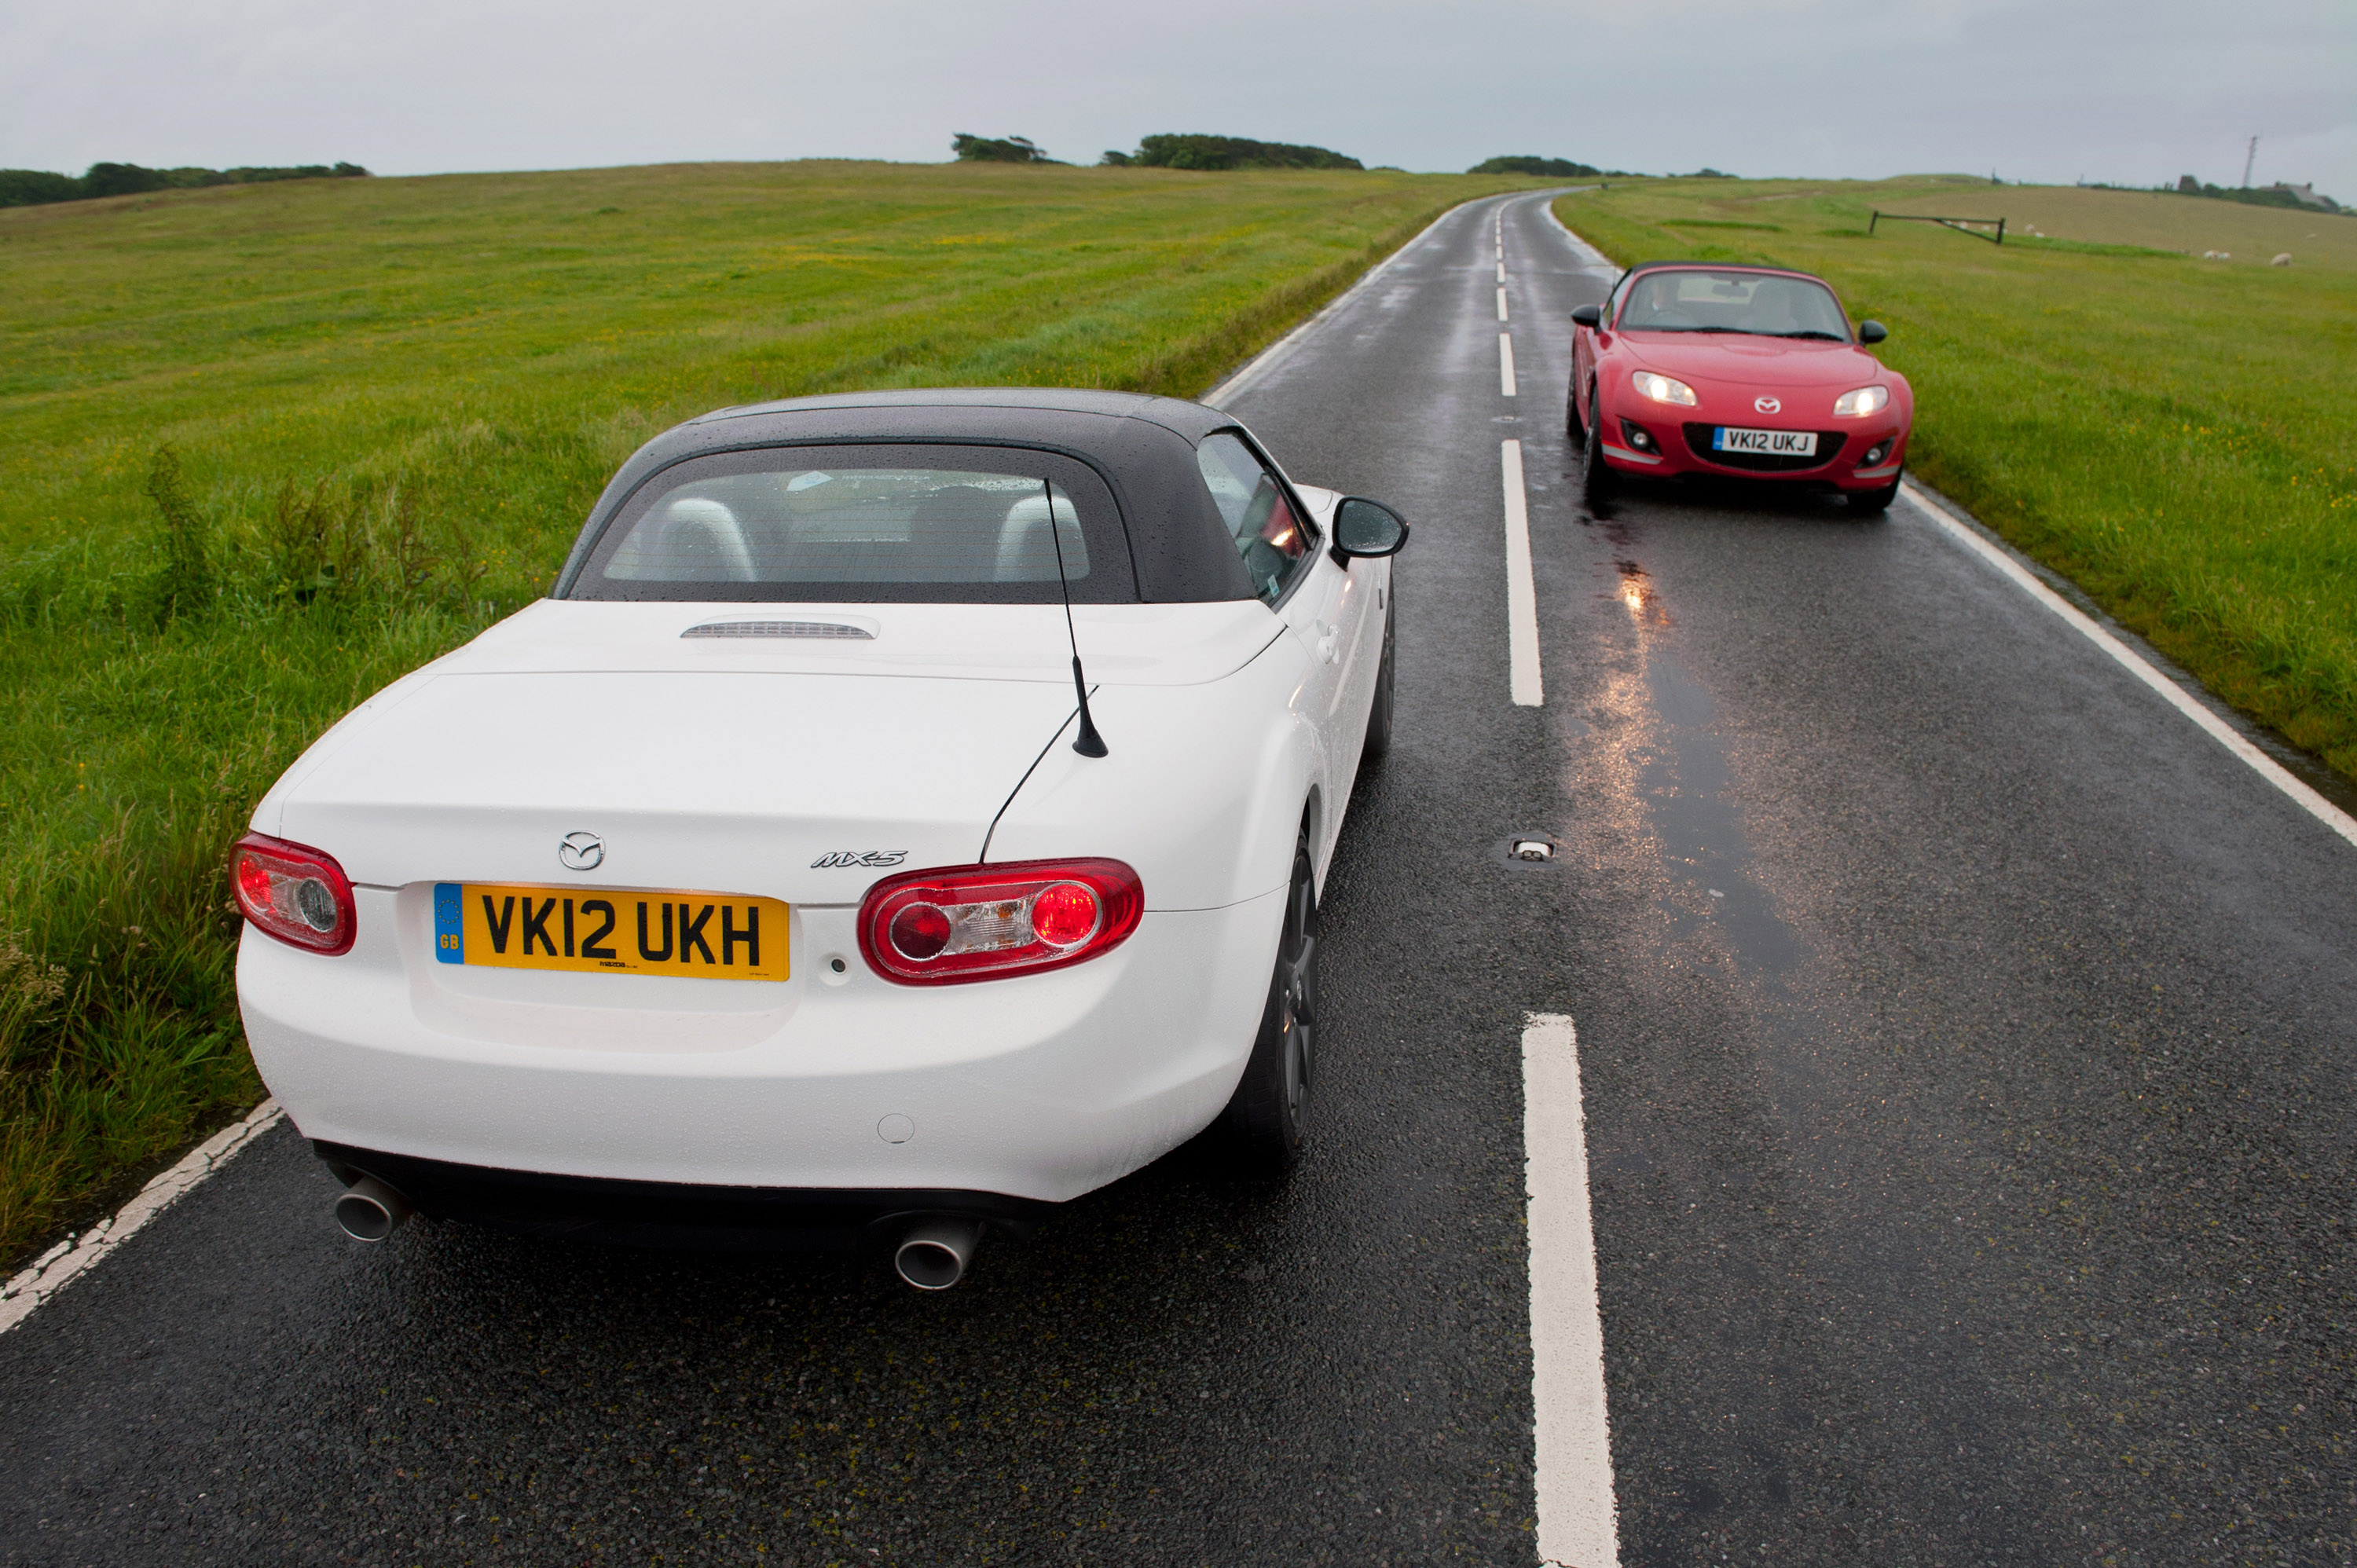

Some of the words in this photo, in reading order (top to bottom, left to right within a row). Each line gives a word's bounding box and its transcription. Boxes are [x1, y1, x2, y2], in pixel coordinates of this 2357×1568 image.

[1729, 431, 1769, 450] VK12
[1773, 434, 1809, 452] UKJ
[811, 851, 908, 868] MX-5
[482, 895, 617, 959] VK12
[637, 902, 760, 967] UKH
[440, 933, 460, 950] GB
